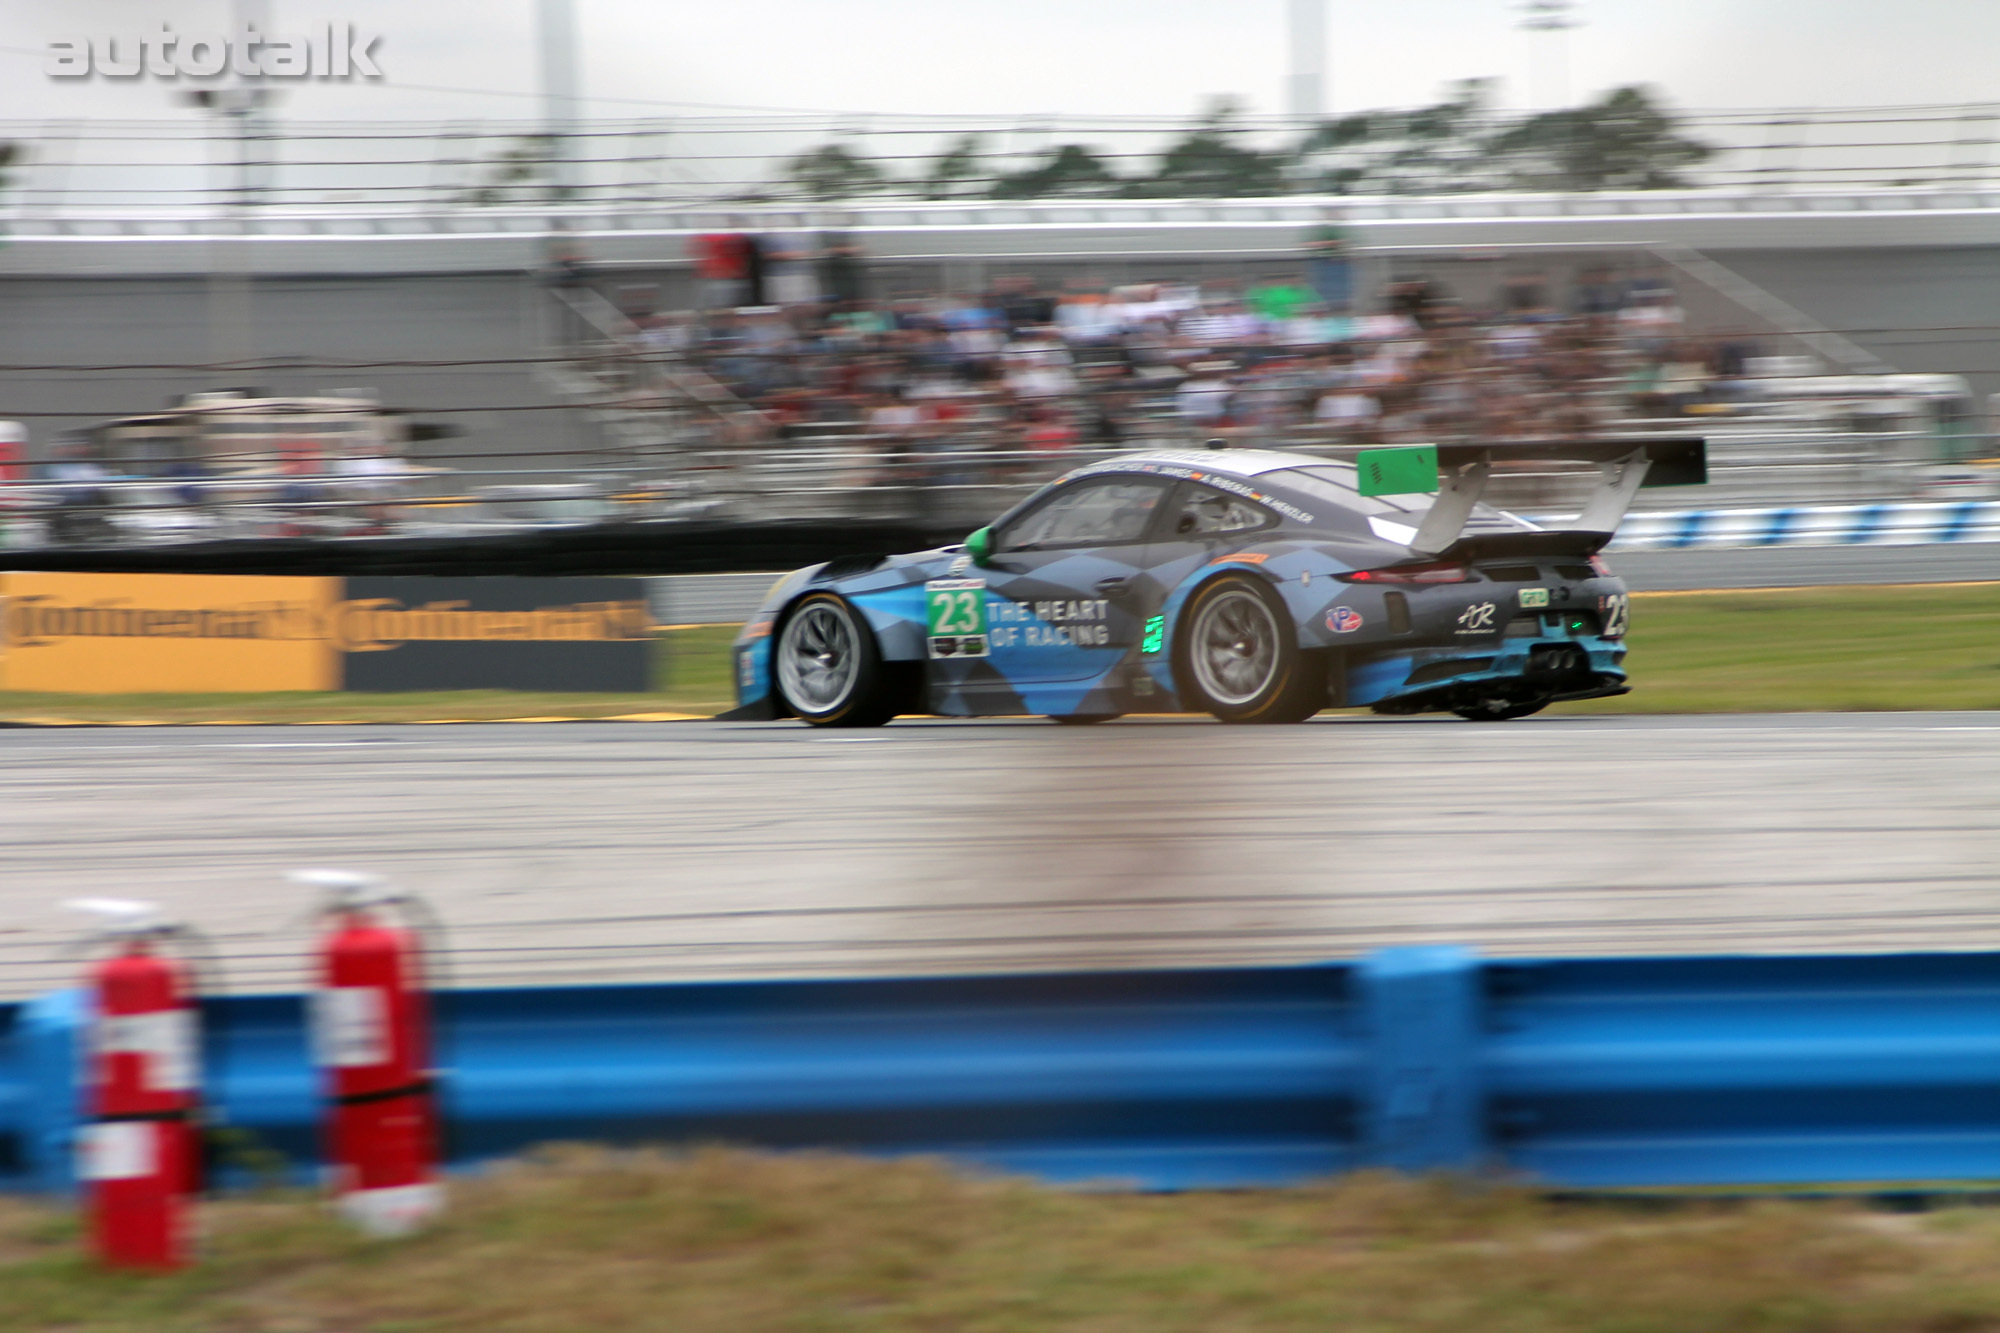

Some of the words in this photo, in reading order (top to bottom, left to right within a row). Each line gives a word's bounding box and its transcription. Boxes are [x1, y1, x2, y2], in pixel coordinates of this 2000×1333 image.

[932, 591, 980, 633] 23
[986, 601, 1030, 622] THE
[1035, 600, 1110, 621] HEART
[1603, 593, 1629, 636] 23
[990, 627, 1019, 647] OF
[1025, 624, 1110, 647] RACING
